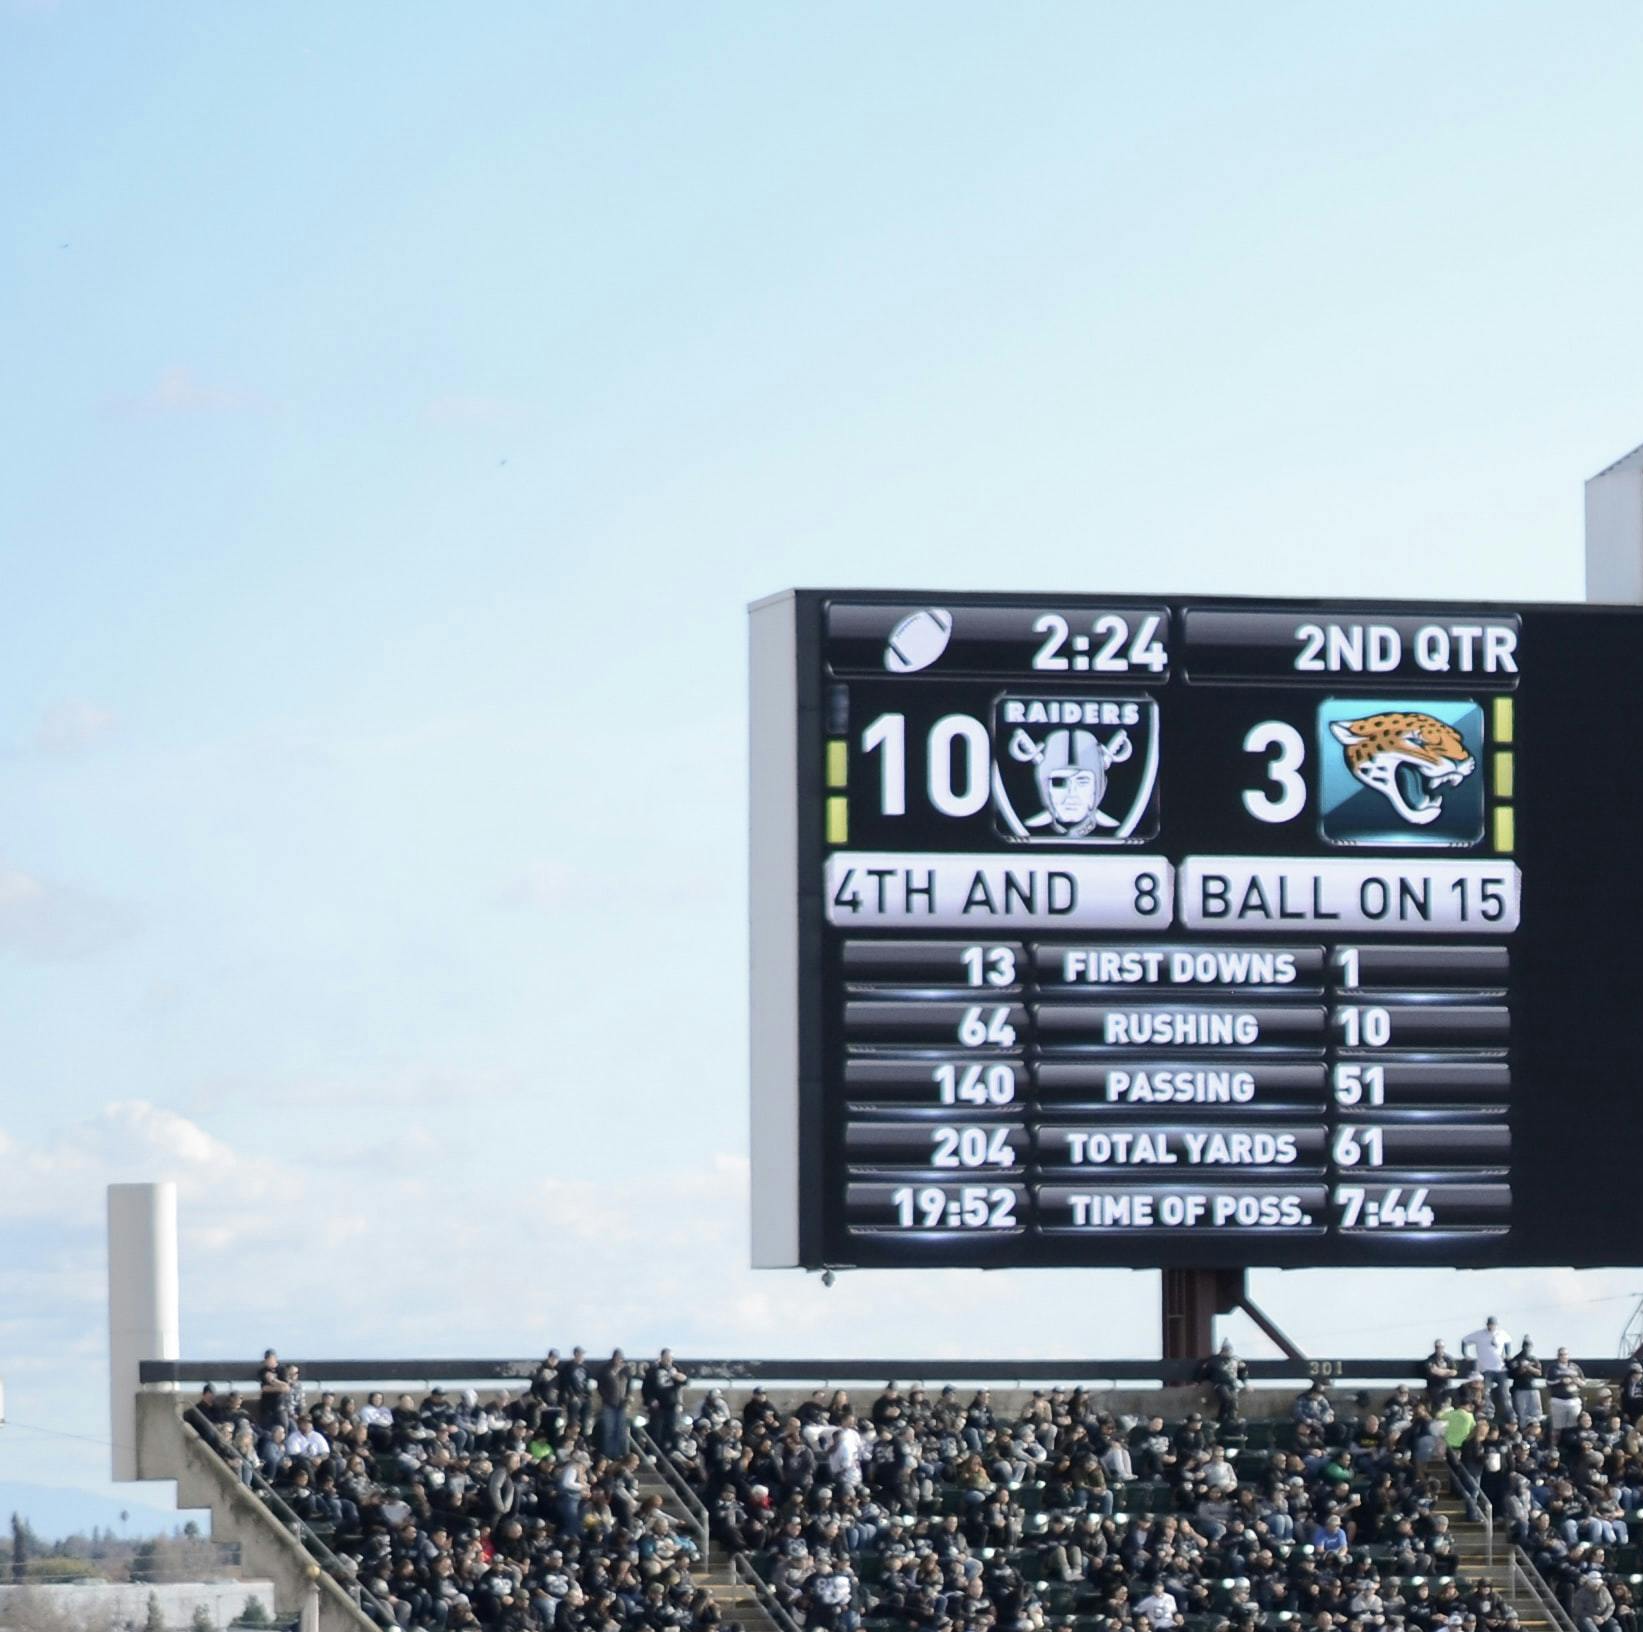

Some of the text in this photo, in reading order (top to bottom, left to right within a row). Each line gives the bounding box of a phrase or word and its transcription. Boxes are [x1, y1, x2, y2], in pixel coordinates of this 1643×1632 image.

[1033, 612, 1168, 672] 2:24
[1295, 623, 1519, 673] 2ND QTR
[1005, 701, 1140, 725] RAIDERS
[862, 713, 991, 817] 10
[1242, 720, 1307, 823] 3
[833, 869, 1160, 917] 4TH AND 8
[1201, 874, 1505, 923] BALL ON 15
[961, 943, 1359, 989] 13 FIRST DOWNS 1
[959, 1004, 1398, 1047] 64 RUSHING 10
[933, 1061, 1392, 1106] 140 PASSING 51
[932, 1124, 1383, 1168] 204 TOTAL YARDS 61
[892, 1185, 1435, 1228] 19:52 TIME OF POSS. 7:44
[1310, 1361, 1342, 1375] 301
